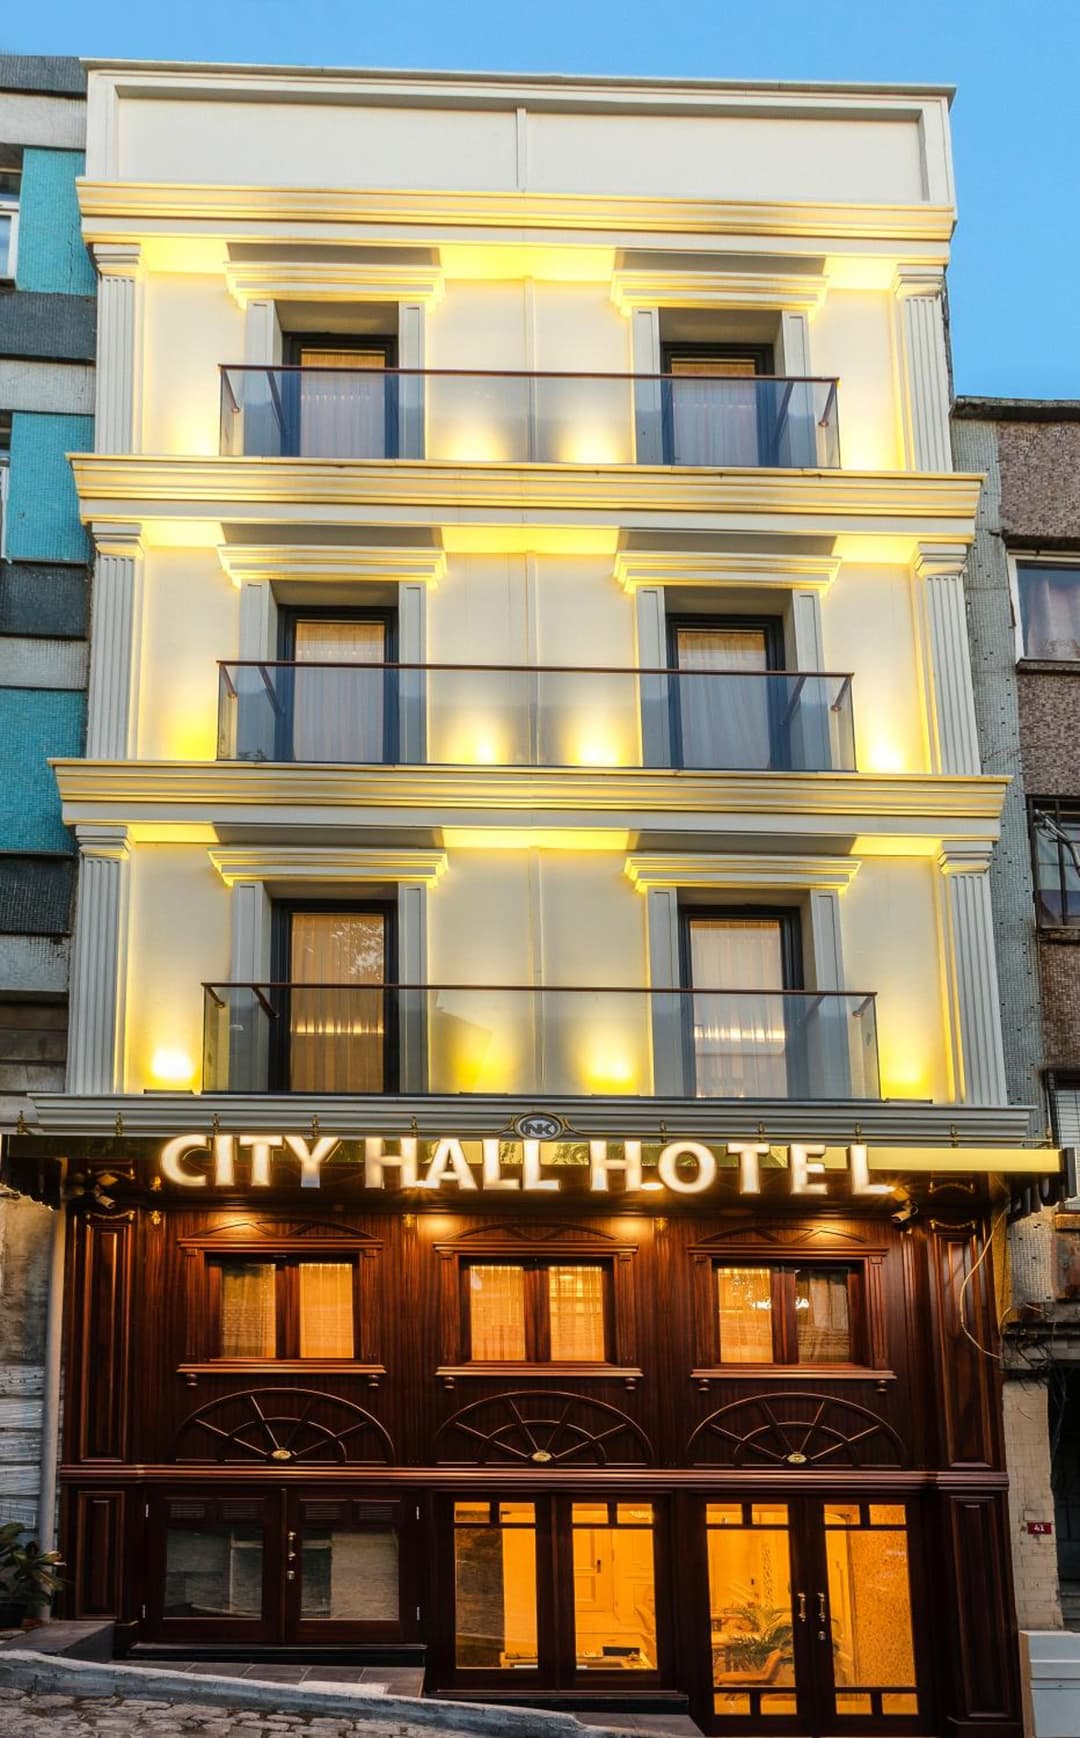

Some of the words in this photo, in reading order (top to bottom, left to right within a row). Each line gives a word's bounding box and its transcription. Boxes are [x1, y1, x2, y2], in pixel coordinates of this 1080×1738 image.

[160, 1134, 339, 1189] CITY
[365, 1137, 560, 1191] HALL
[589, 1140, 893, 1196] HOTEL
